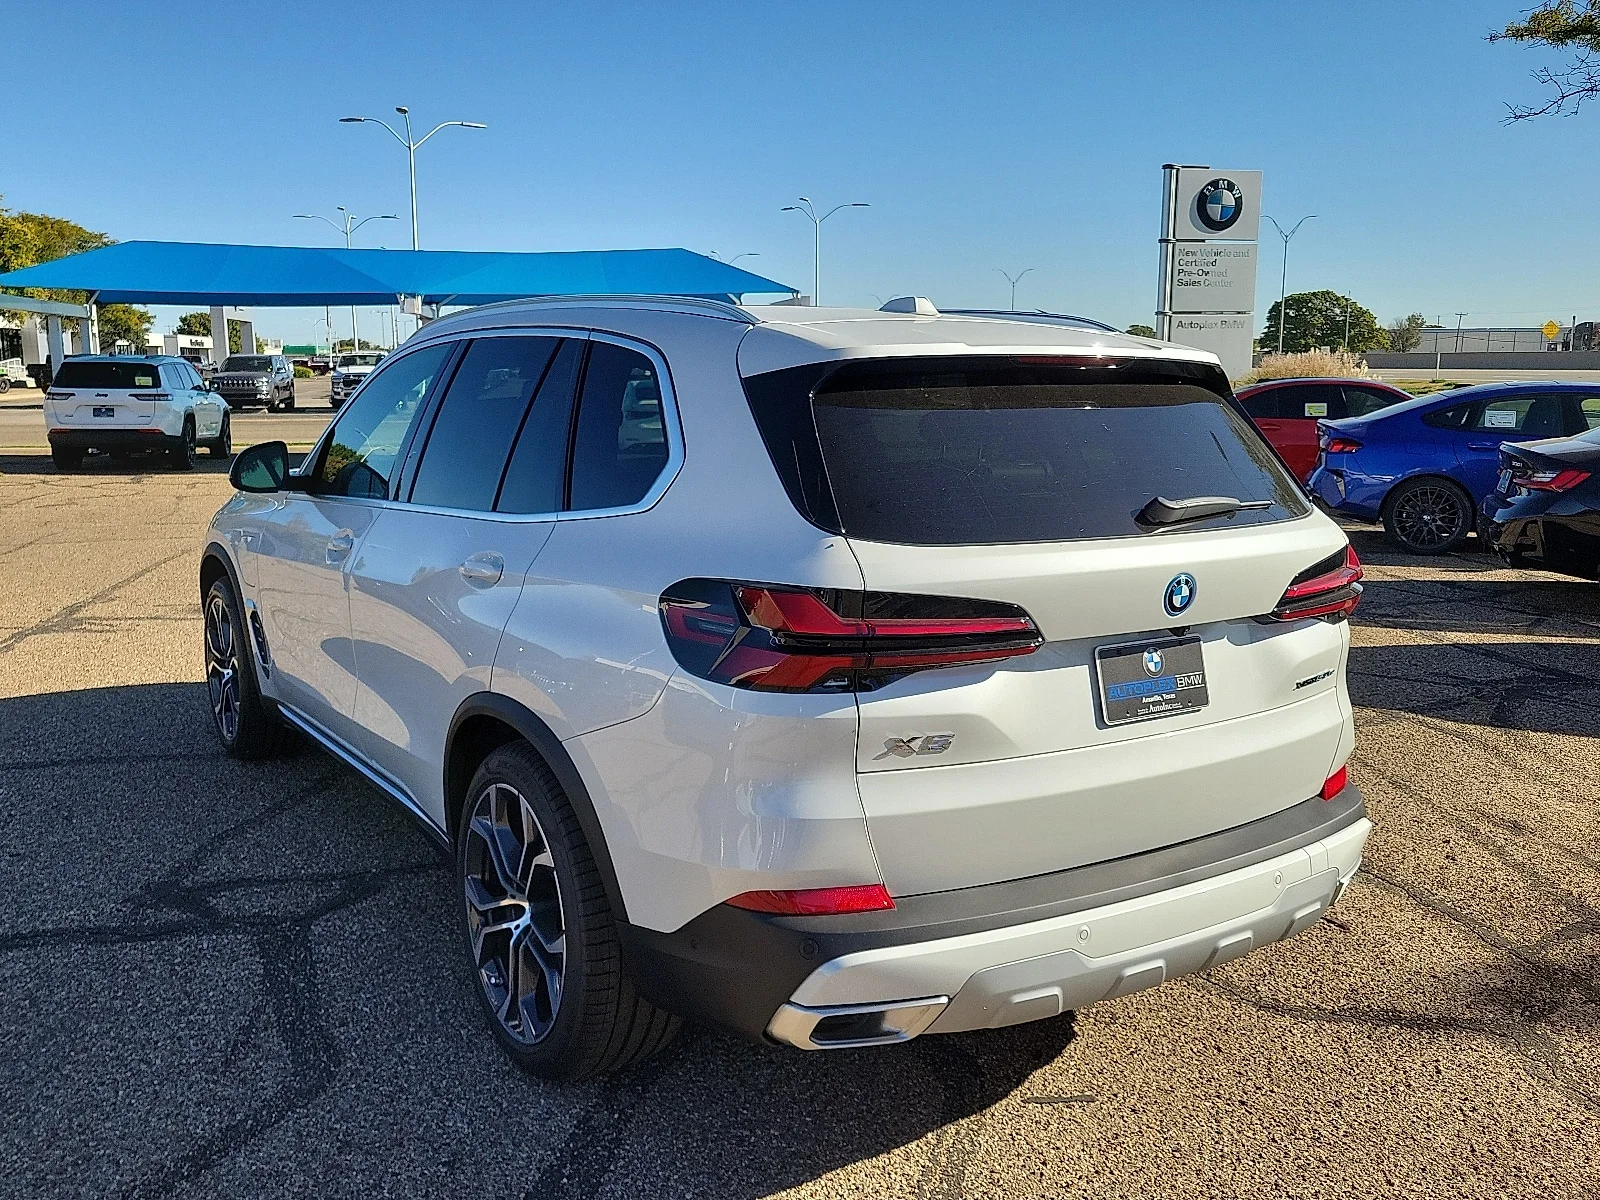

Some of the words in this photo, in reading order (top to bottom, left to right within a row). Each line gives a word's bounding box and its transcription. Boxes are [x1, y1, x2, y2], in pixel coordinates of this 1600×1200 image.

[1178, 249, 1198, 257] New
[1200, 249, 1231, 257] Vehicle
[1233, 249, 1250, 257] and
[1178, 259, 1217, 267] Certified
[1177, 269, 1228, 277] Pre-Owned
[1177, 279, 1202, 287] Sales
[1203, 279, 1234, 287] Center
[1176, 320, 1218, 330] Autoplex
[1220, 320, 1245, 329] BMW
